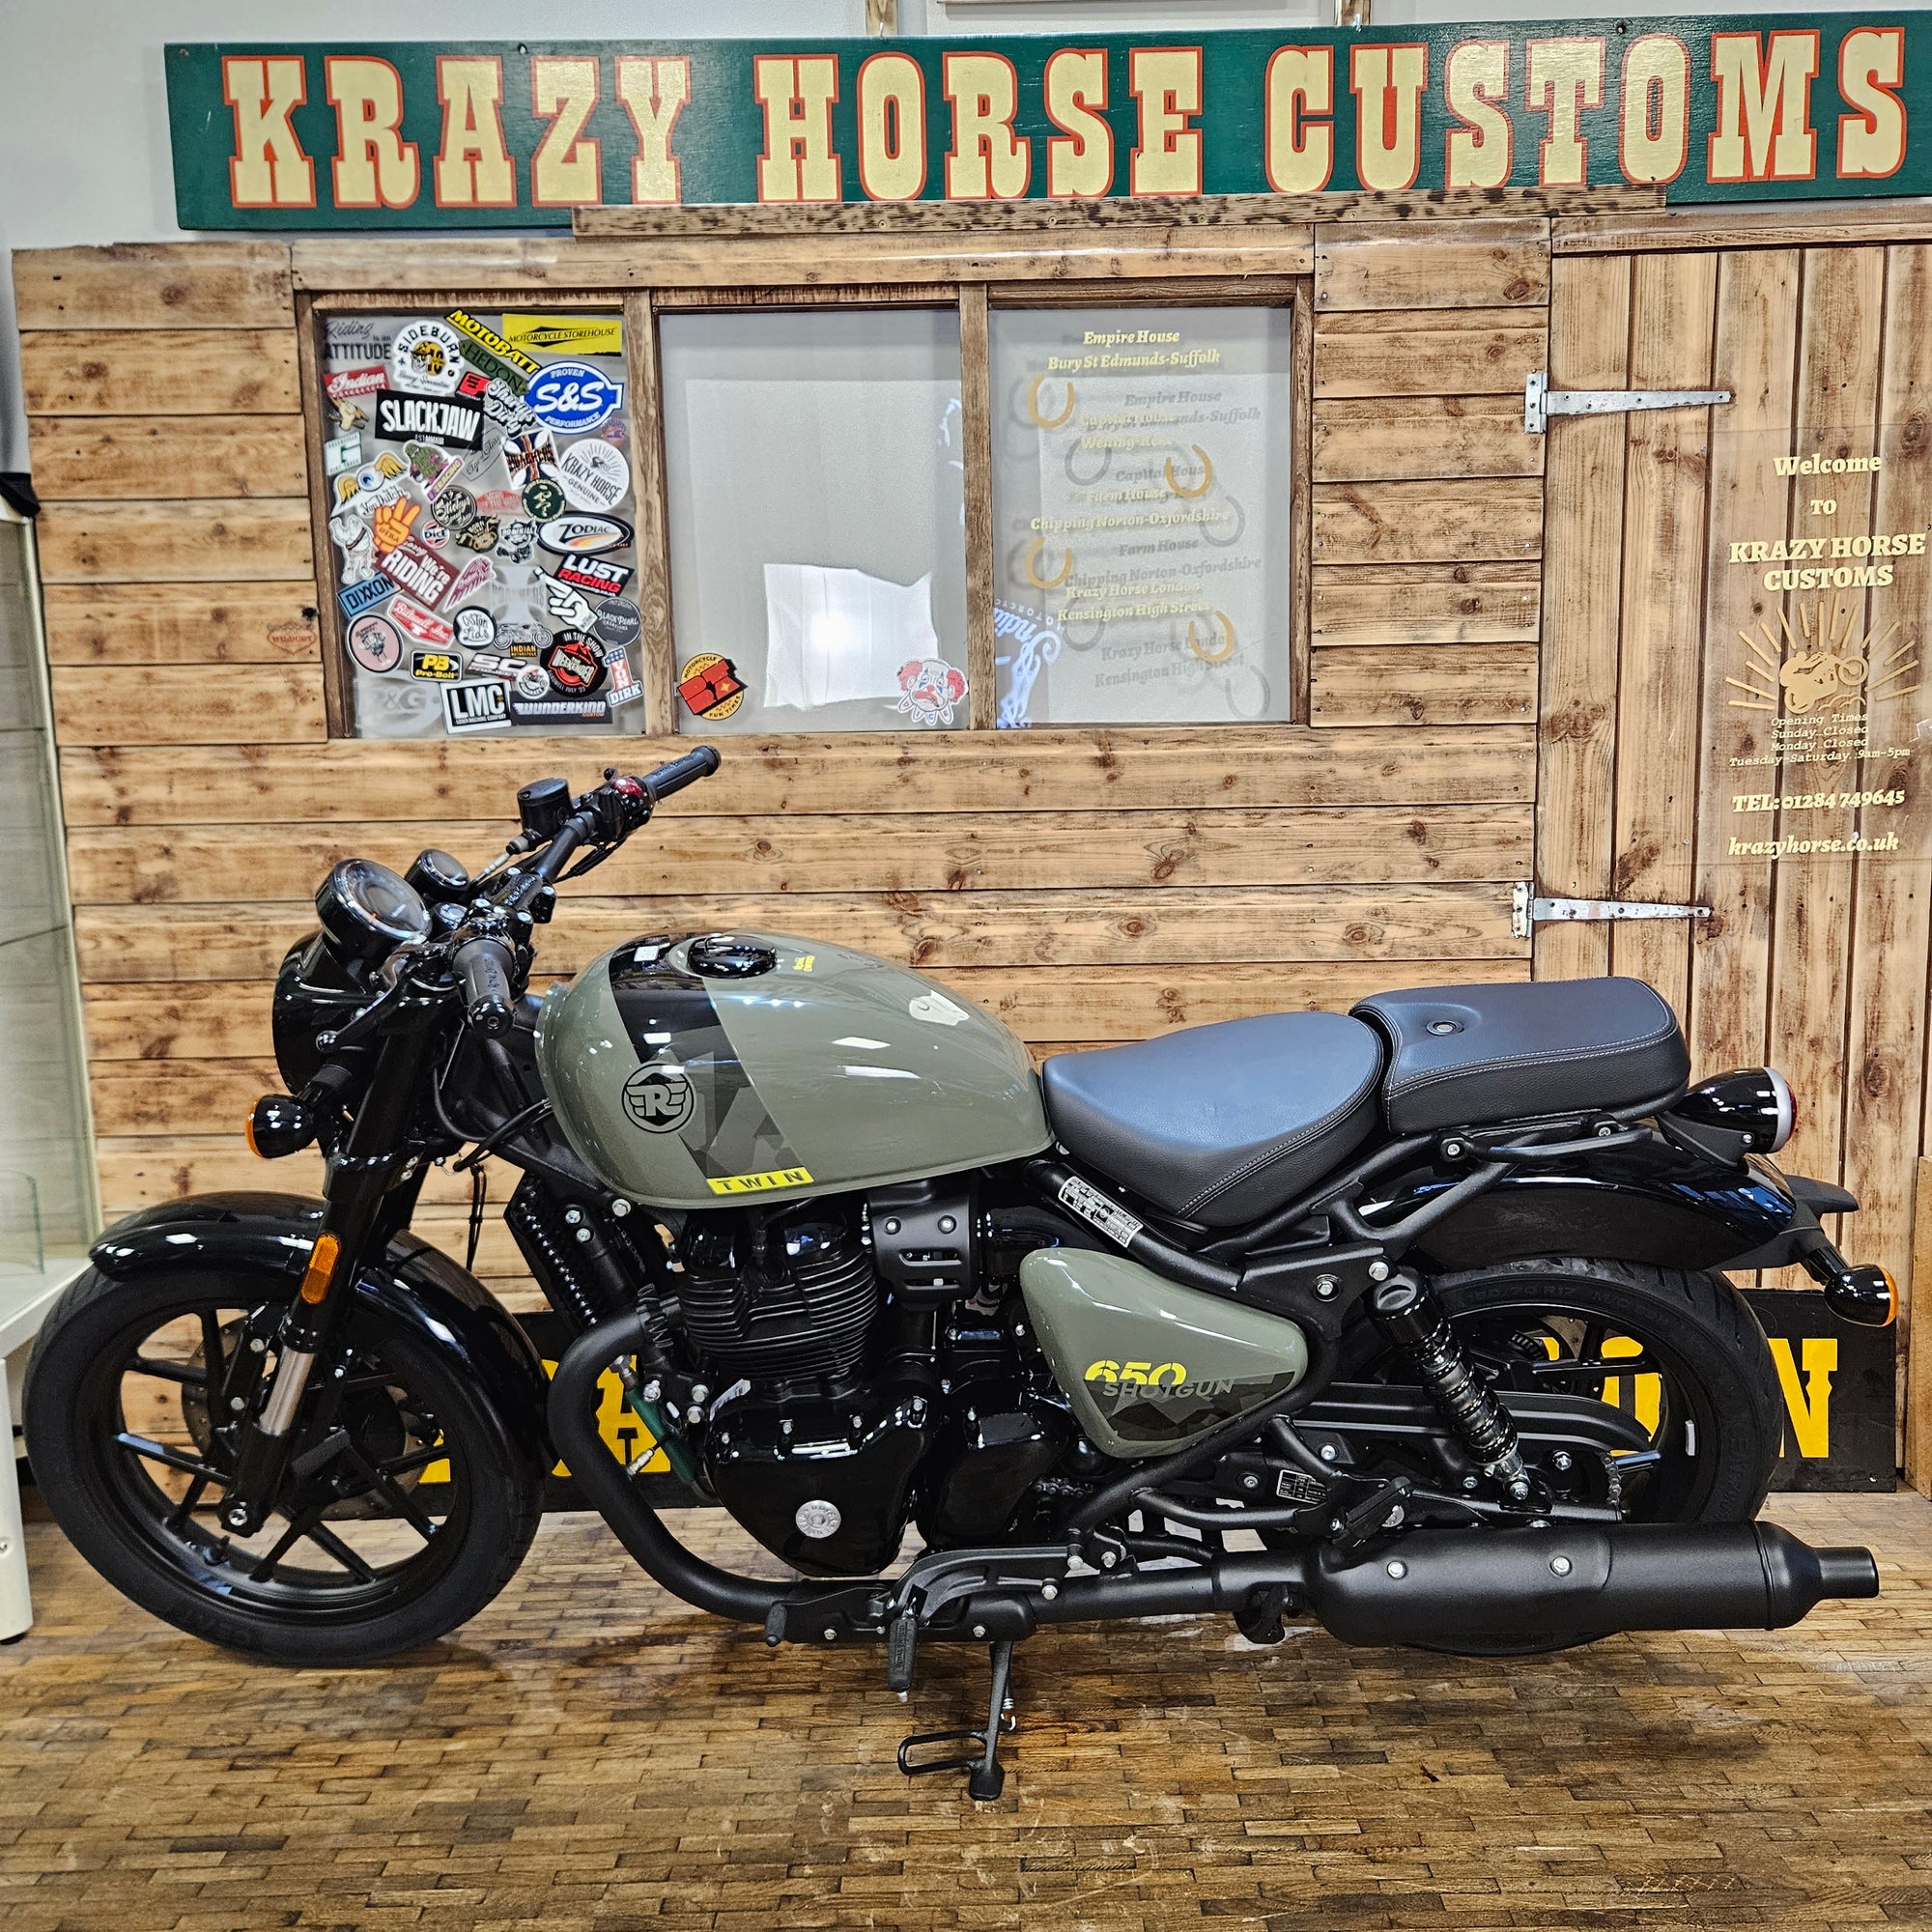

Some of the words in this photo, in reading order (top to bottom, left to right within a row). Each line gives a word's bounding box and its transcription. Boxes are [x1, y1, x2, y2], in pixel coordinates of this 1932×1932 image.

[222, 54, 690, 210] KRAZY
[753, 46, 1203, 203] HORSE
[1265, 27, 1908, 192] CUSTOMS
[327, 321, 374, 340] Riding
[509, 329, 562, 343] MOTORCYCLE
[563, 327, 615, 339] STOREHOUSE
[1083, 329, 1135, 348] Empire
[1135, 329, 1179, 344] House
[325, 343, 391, 359] ATTITUDE
[398, 325, 460, 364] SIDEBURN
[451, 310, 540, 374] MOTOBATT
[466, 343, 523, 393] HEDON
[1048, 356, 1082, 373] Bury
[1083, 355, 1099, 368] St
[1099, 349, 1220, 368] Edmunds-Suffolk
[327, 372, 384, 393] Indian
[551, 368, 584, 379] PROVEN
[533, 382, 605, 413] S&S
[380, 400, 481, 441] SLACKJAW
[545, 412, 601, 428] PERFORMANCE
[1773, 453, 1882, 476] Welcome
[561, 452, 591, 481] KRAZY
[592, 473, 623, 506] HORSE
[568, 479, 600, 503] GENUINE
[1810, 499, 1837, 515] TO
[558, 524, 610, 544] ZODIAC
[1030, 517, 1095, 535] Chipping
[1729, 537, 1827, 563] KRAZY
[1829, 533, 1926, 558] HORSE
[381, 549, 443, 604] RIDING
[420, 554, 451, 585] We're
[563, 554, 628, 582] LUST
[1763, 565, 1894, 591] CUSTOMS
[557, 568, 621, 594] RACING
[1065, 585, 1108, 601] Krazy
[1109, 582, 1148, 597] Horse
[346, 576, 395, 611] DIXXON
[1058, 607, 1134, 621] Kensington
[1135, 603, 1171, 618] High
[511, 645, 536, 654] INDIAN
[564, 632, 572, 641] IN
[573, 632, 586, 643] THE
[586, 638, 604, 657] SHOW
[422, 654, 450, 670] PB
[552, 649, 595, 683] WEEKENDER
[684, 657, 717, 678] MOTORCYCLE
[415, 669, 455, 679] Pro-Bolt
[611, 661, 631, 687] VON
[450, 684, 505, 719] LMC
[610, 685, 641, 704] DIRK
[725, 696, 740, 713] TIMES
[513, 701, 606, 715] WUNDERKIND
[1771, 716, 1824, 727] Opening
[1832, 713, 1869, 723] Times
[1781, 792, 1835, 810] 01284
[1839, 789, 1905, 808] 749645
[1728, 832, 1899, 859] krazyhorse.co.uk
[717, 1172, 807, 1191] TWIN
[1084, 1360, 1187, 1386] 650
[1102, 1378, 1235, 1400] SHOTGUN
